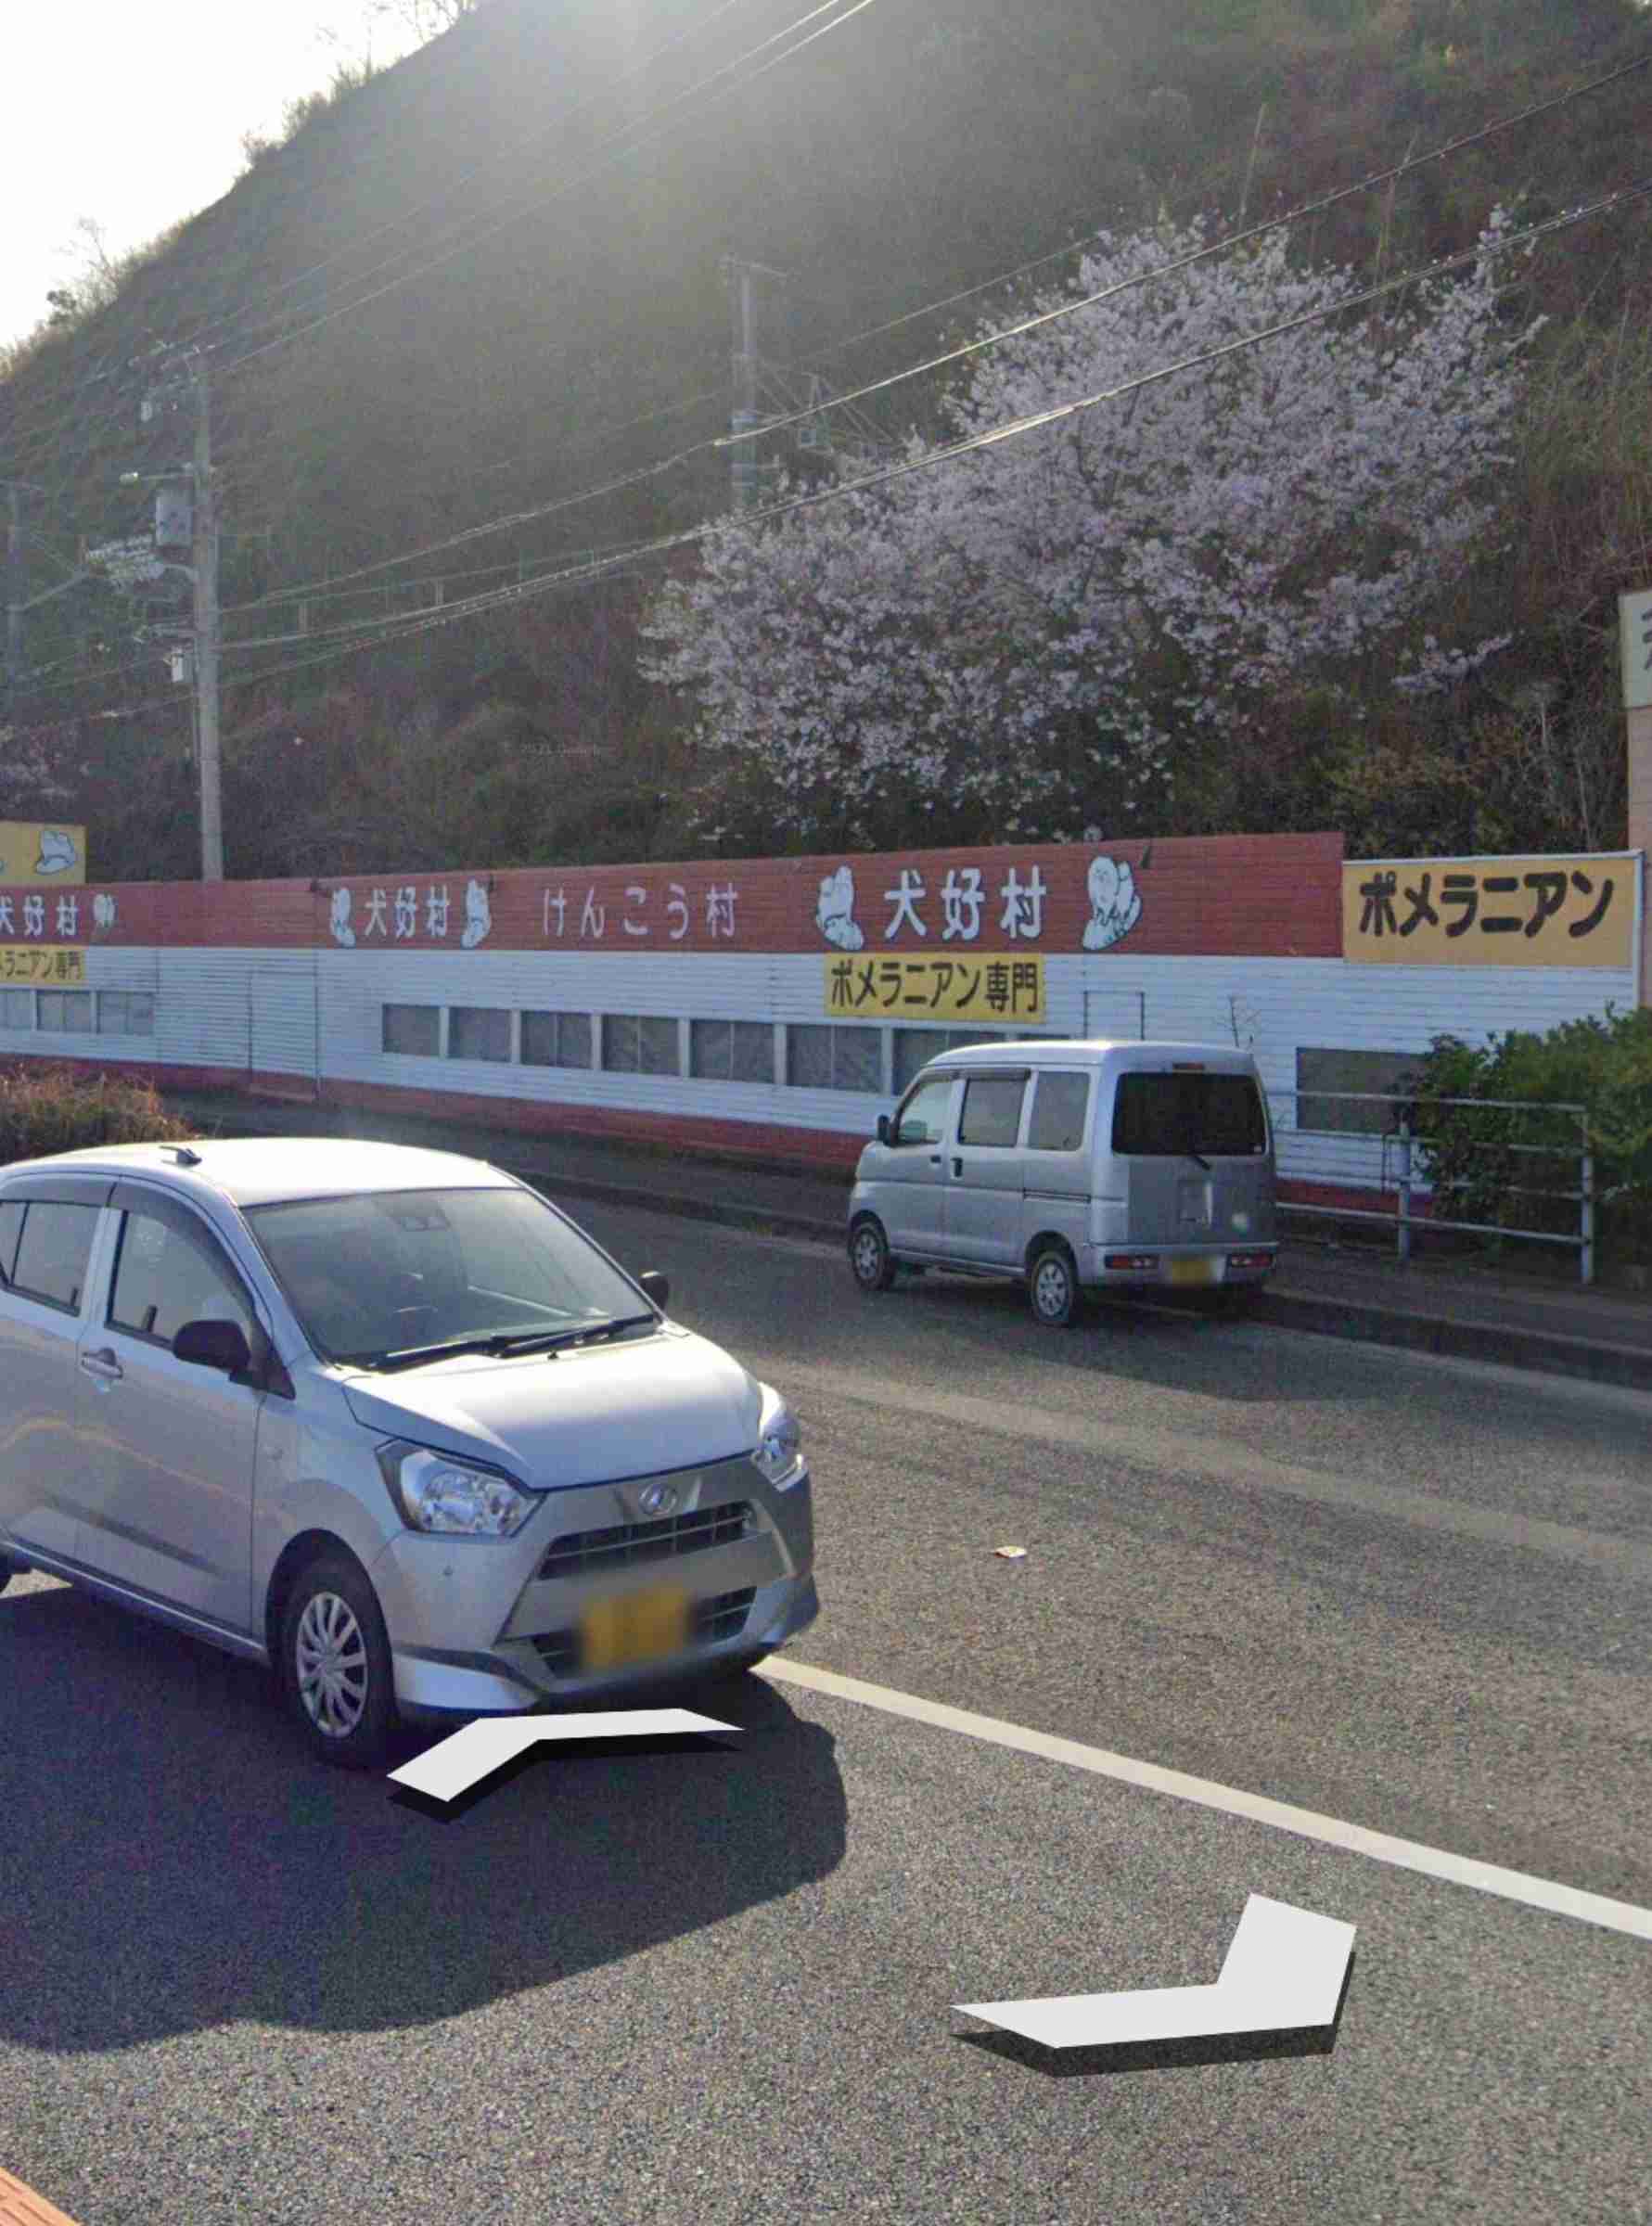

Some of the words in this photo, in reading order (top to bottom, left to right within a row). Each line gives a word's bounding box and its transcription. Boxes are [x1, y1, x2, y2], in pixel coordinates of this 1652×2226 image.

[365, 886, 450, 938] 犬好村
[544, 882, 738, 940] けんこう村
[884, 864, 1046, 940] 犬好村
[1359, 870, 1614, 938] ポメラニアン
[0, 950, 81, 980] ラニアン専門
[831, 959, 1038, 1014] ポメラニアン専門
